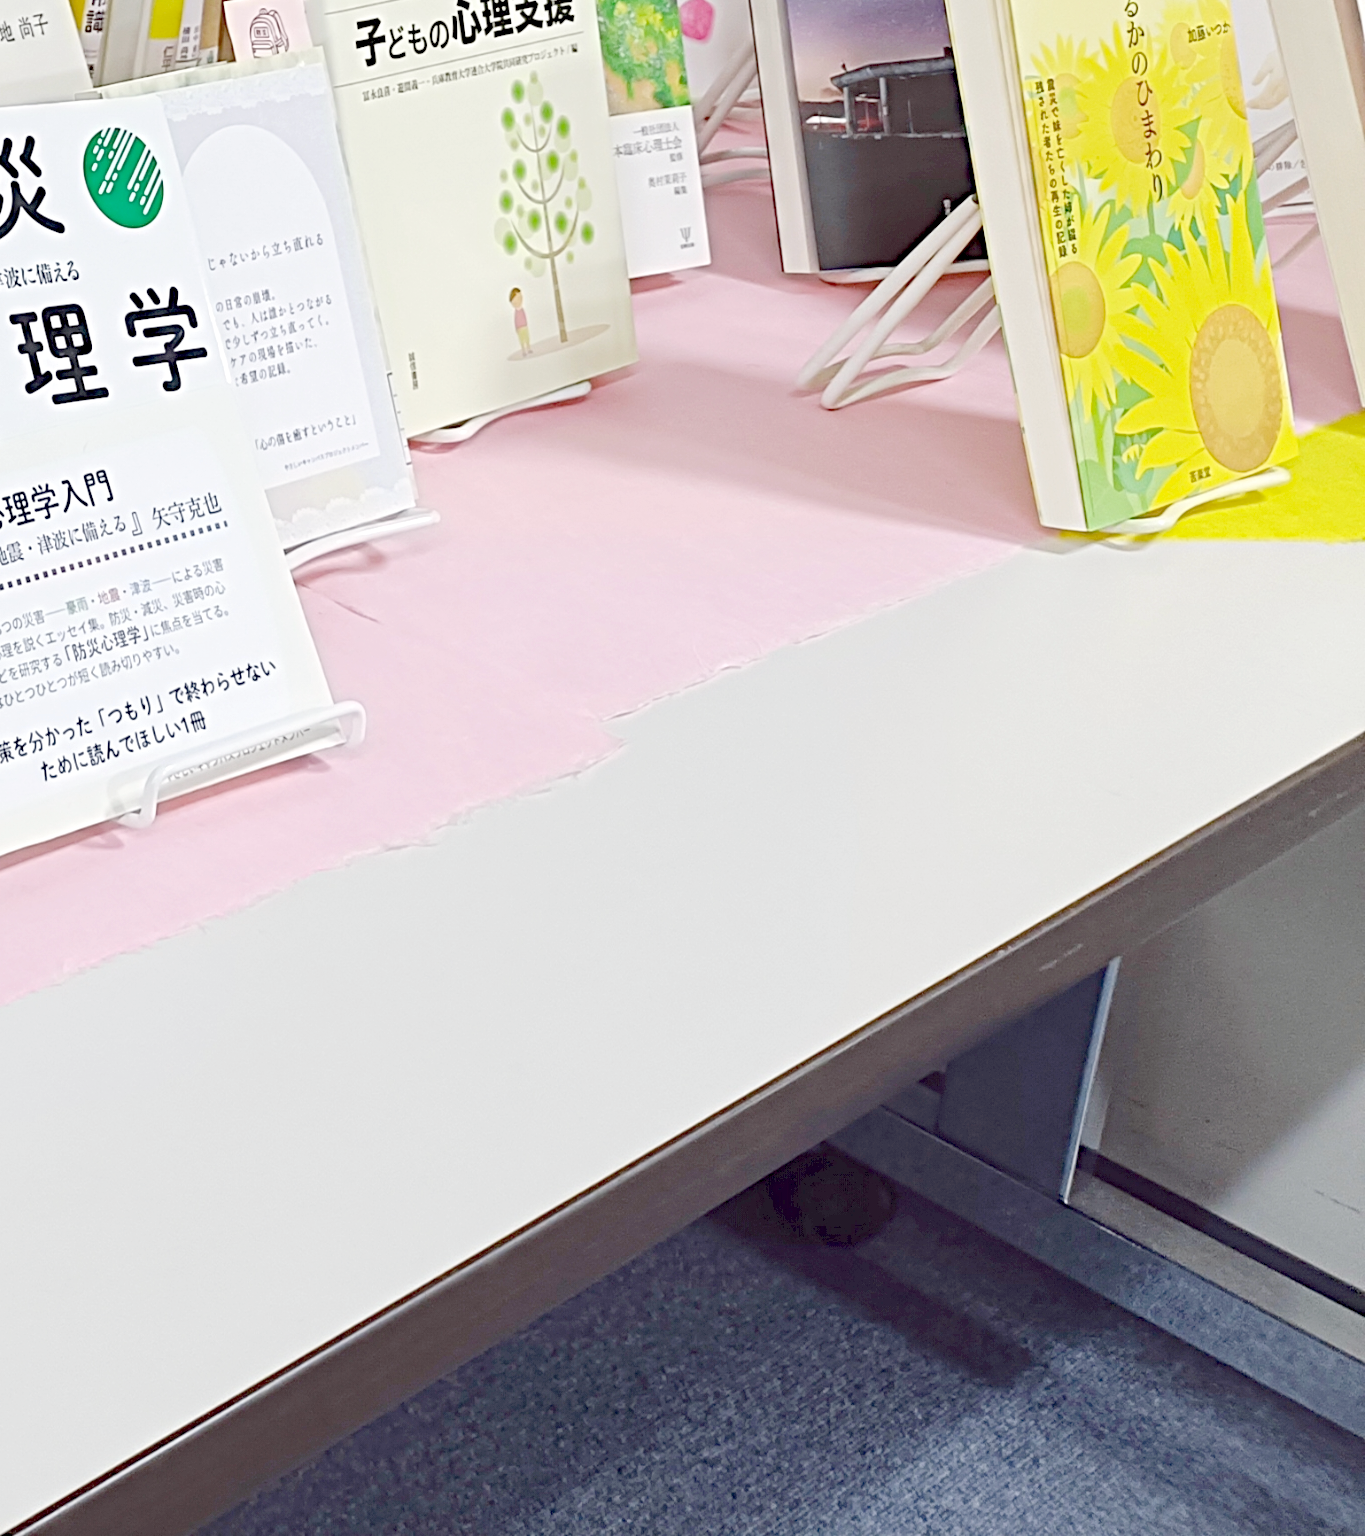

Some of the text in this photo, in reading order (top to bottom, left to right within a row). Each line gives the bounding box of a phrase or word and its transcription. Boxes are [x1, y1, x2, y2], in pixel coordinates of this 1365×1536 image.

[16, 12, 49, 40] 尚子
[1187, 22, 1231, 44] 加藤いつか
[1033, 80, 1068, 259] 残された者たちの再生の記録
[207, 233, 324, 272] じゃないから立ち直れる
[254, 414, 357, 451] 「心の傷を癒すということ」
[151, 491, 223, 534] 矢守克也
[40, 711, 207, 783] ために読んでほしい1冊
